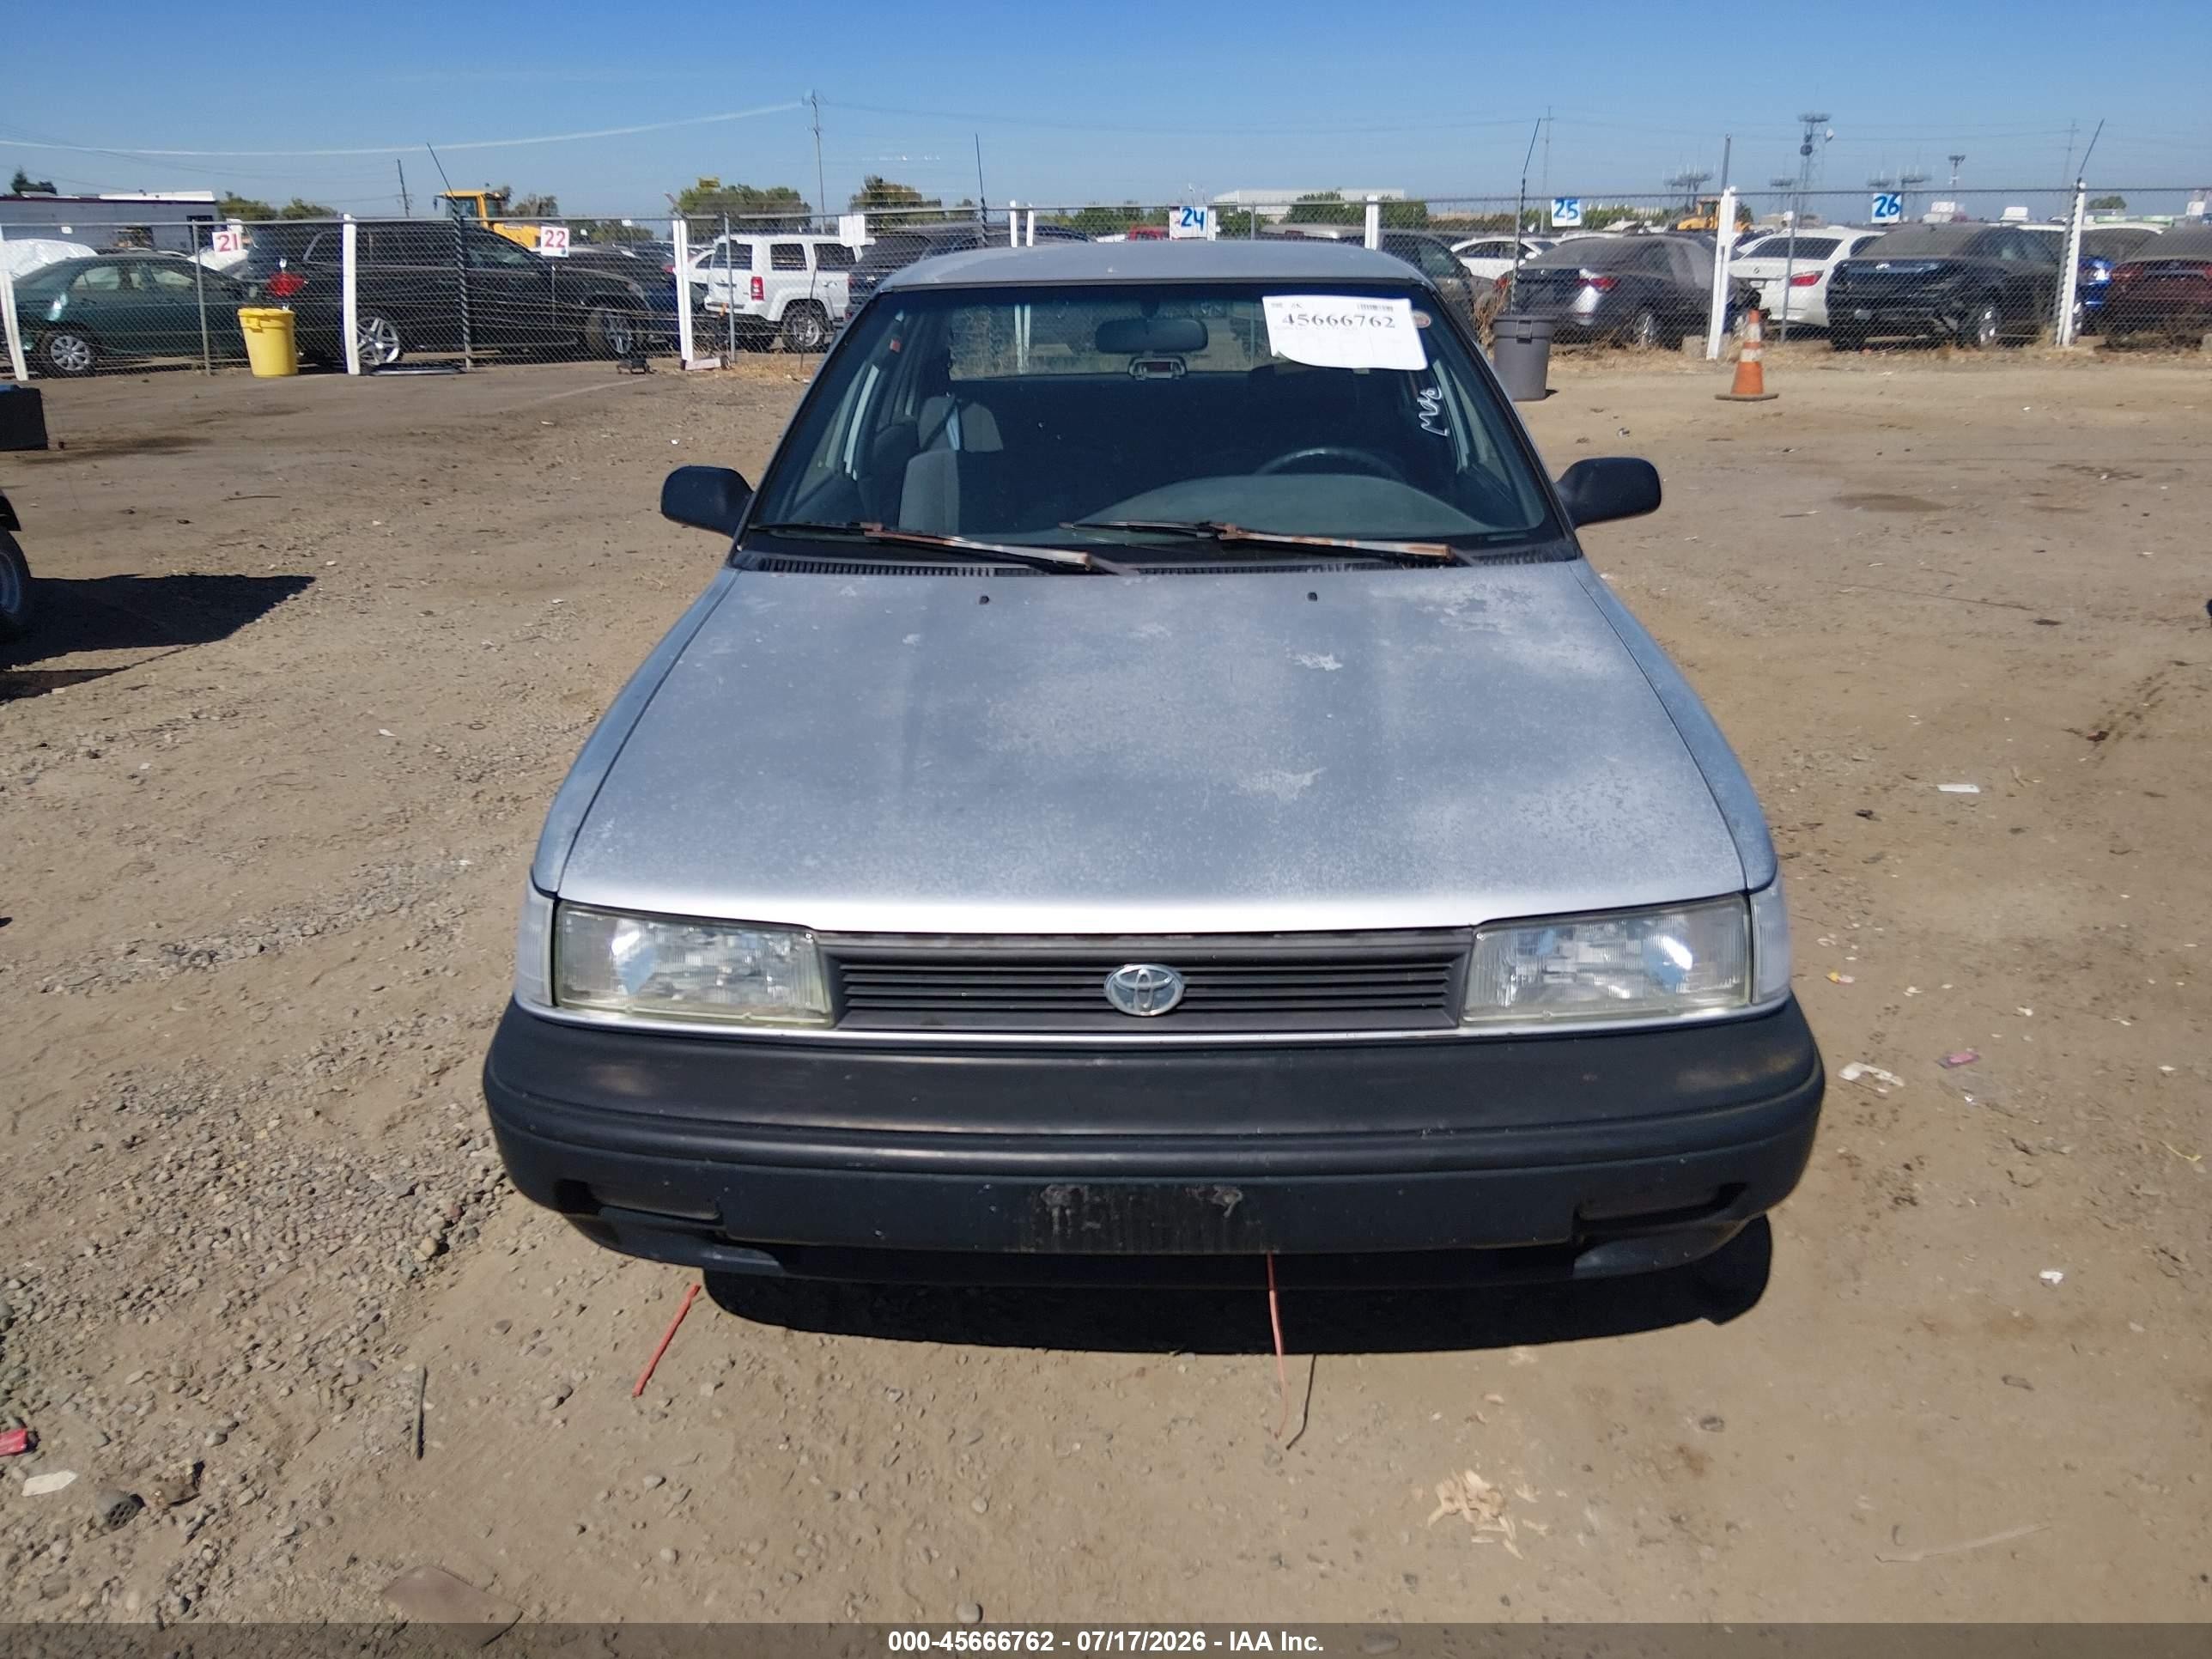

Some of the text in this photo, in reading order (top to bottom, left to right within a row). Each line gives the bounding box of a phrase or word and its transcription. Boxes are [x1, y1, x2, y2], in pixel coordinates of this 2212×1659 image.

[1553, 198, 1578, 220] 25
[1874, 191, 1899, 217] 26
[1181, 207, 1204, 231] 24
[218, 234, 238, 252] 21
[544, 229, 566, 248] 22
[1282, 313, 1395, 329] 45666762
